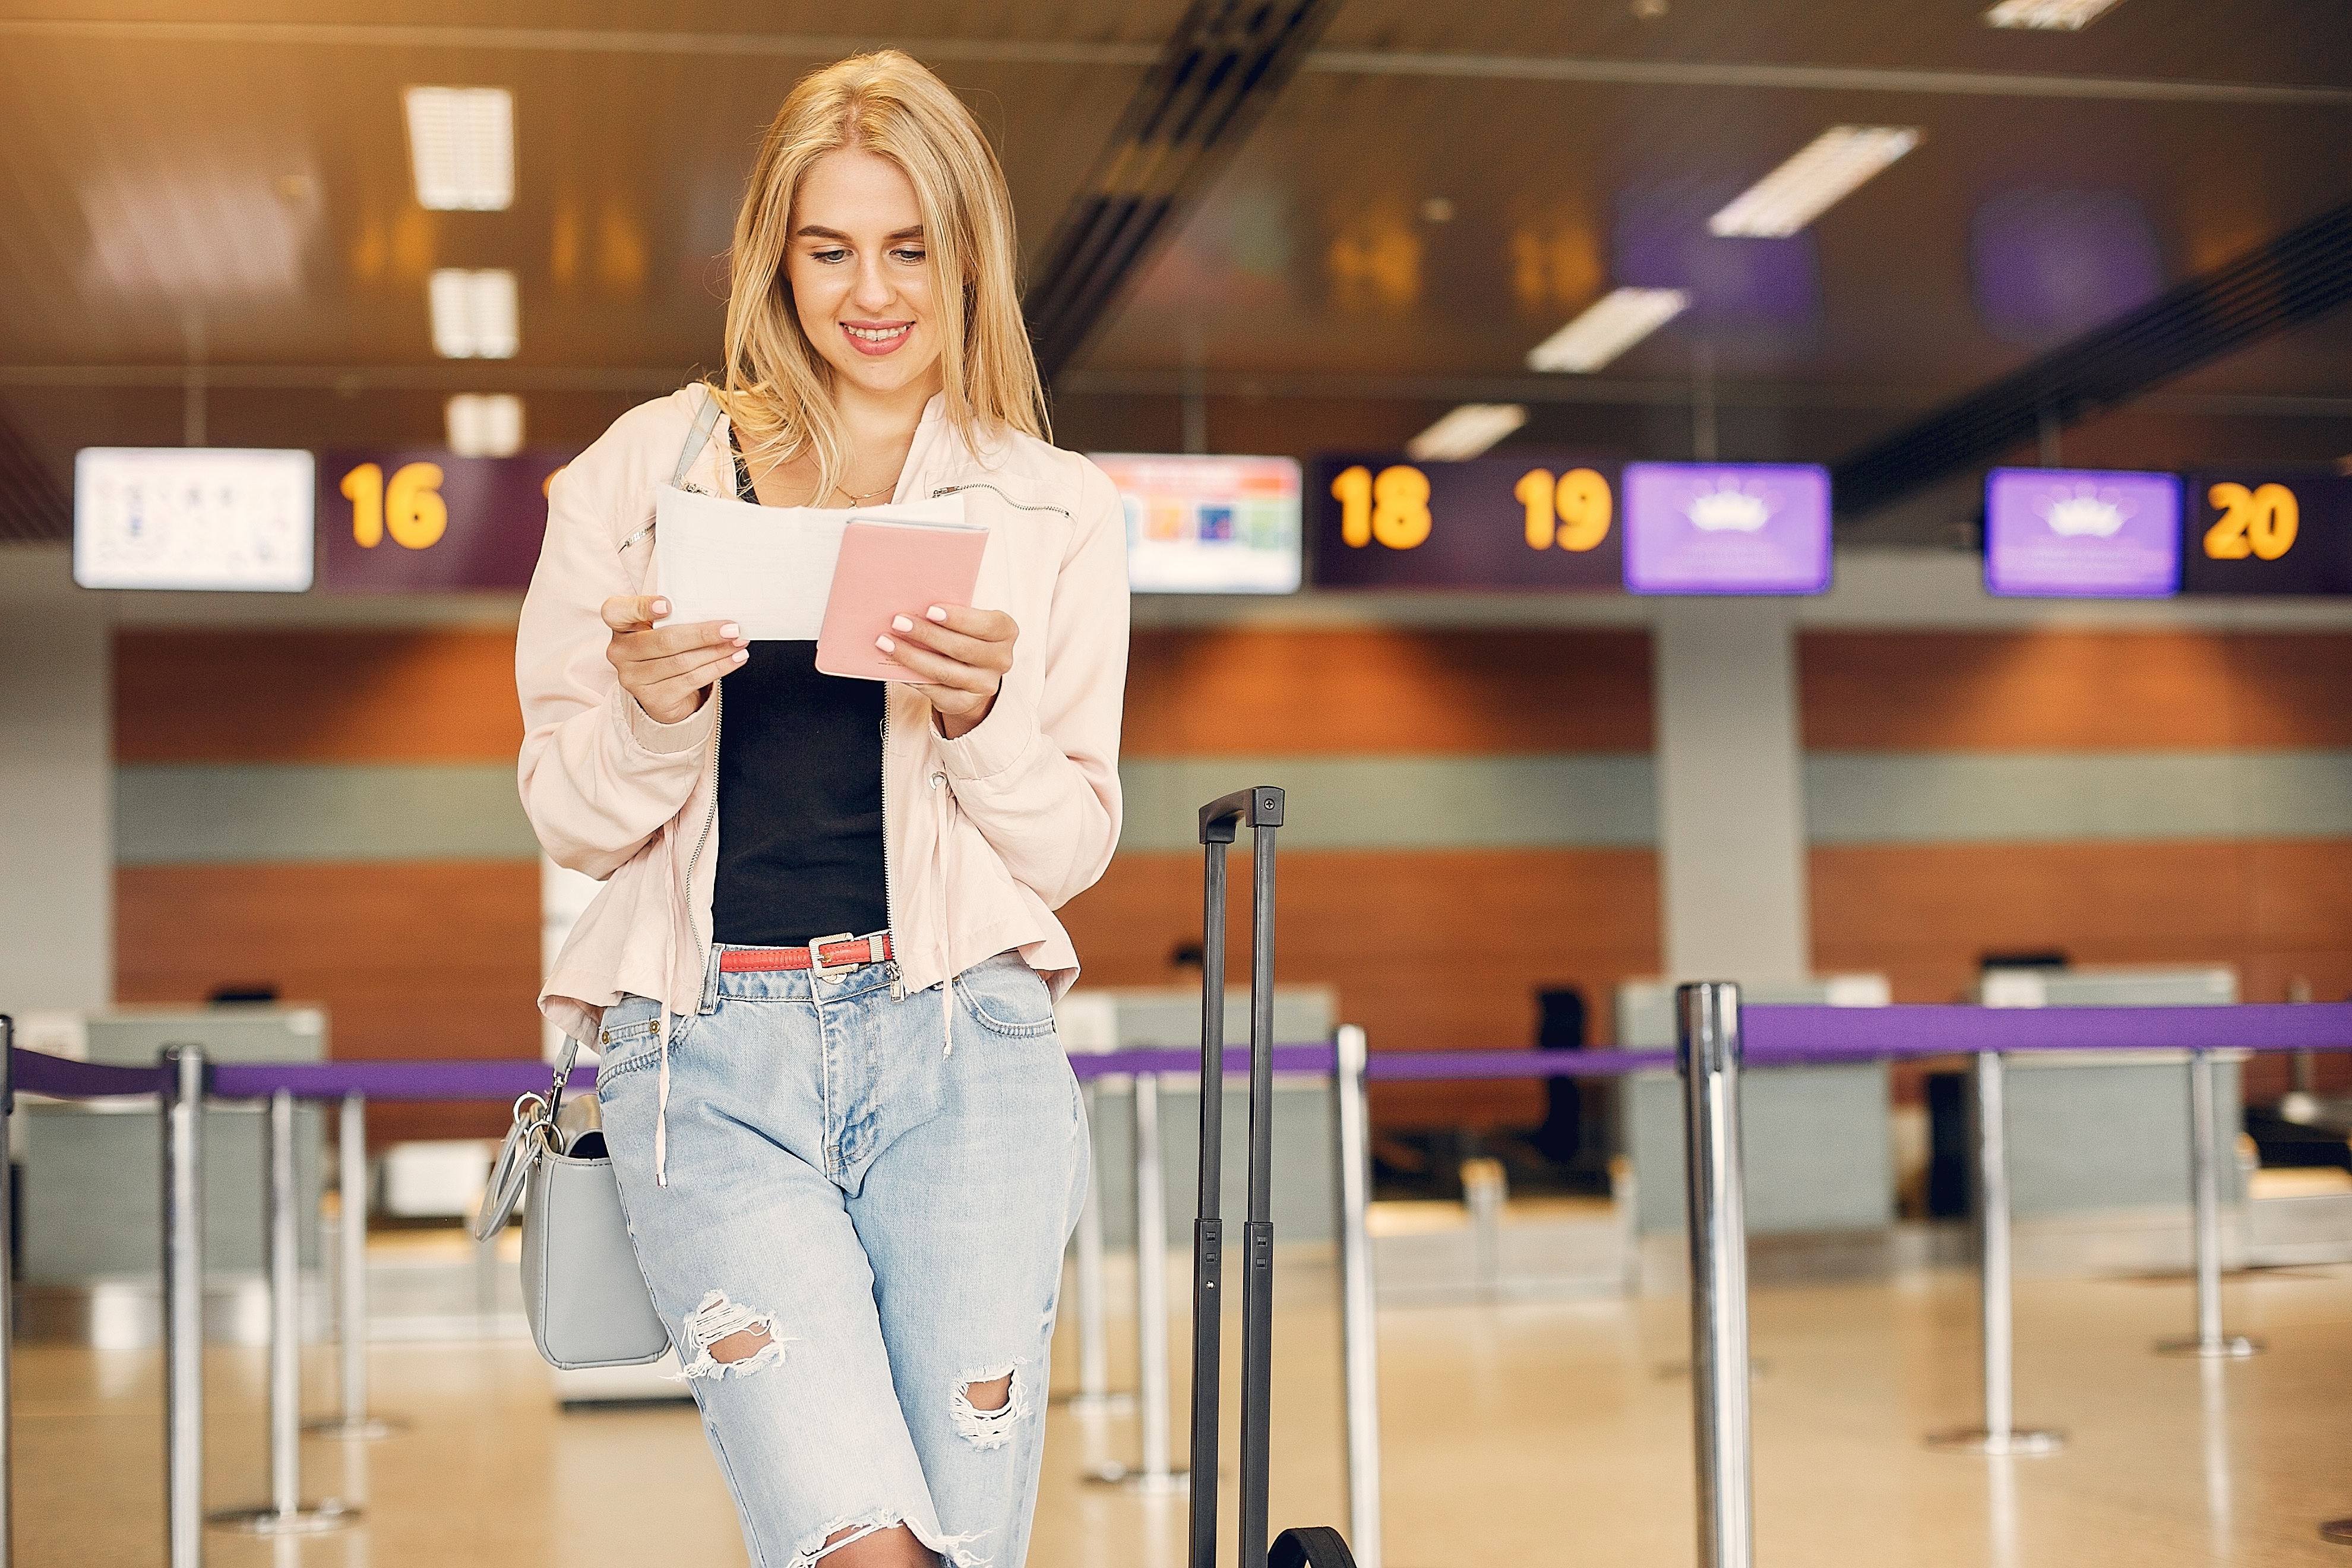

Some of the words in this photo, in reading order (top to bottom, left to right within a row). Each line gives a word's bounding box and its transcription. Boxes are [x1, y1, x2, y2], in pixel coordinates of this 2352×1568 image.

[340, 461, 448, 549] 16
[1331, 465, 1432, 550] 18
[1515, 467, 1613, 552] 19
[2203, 482, 2299, 560] 20
